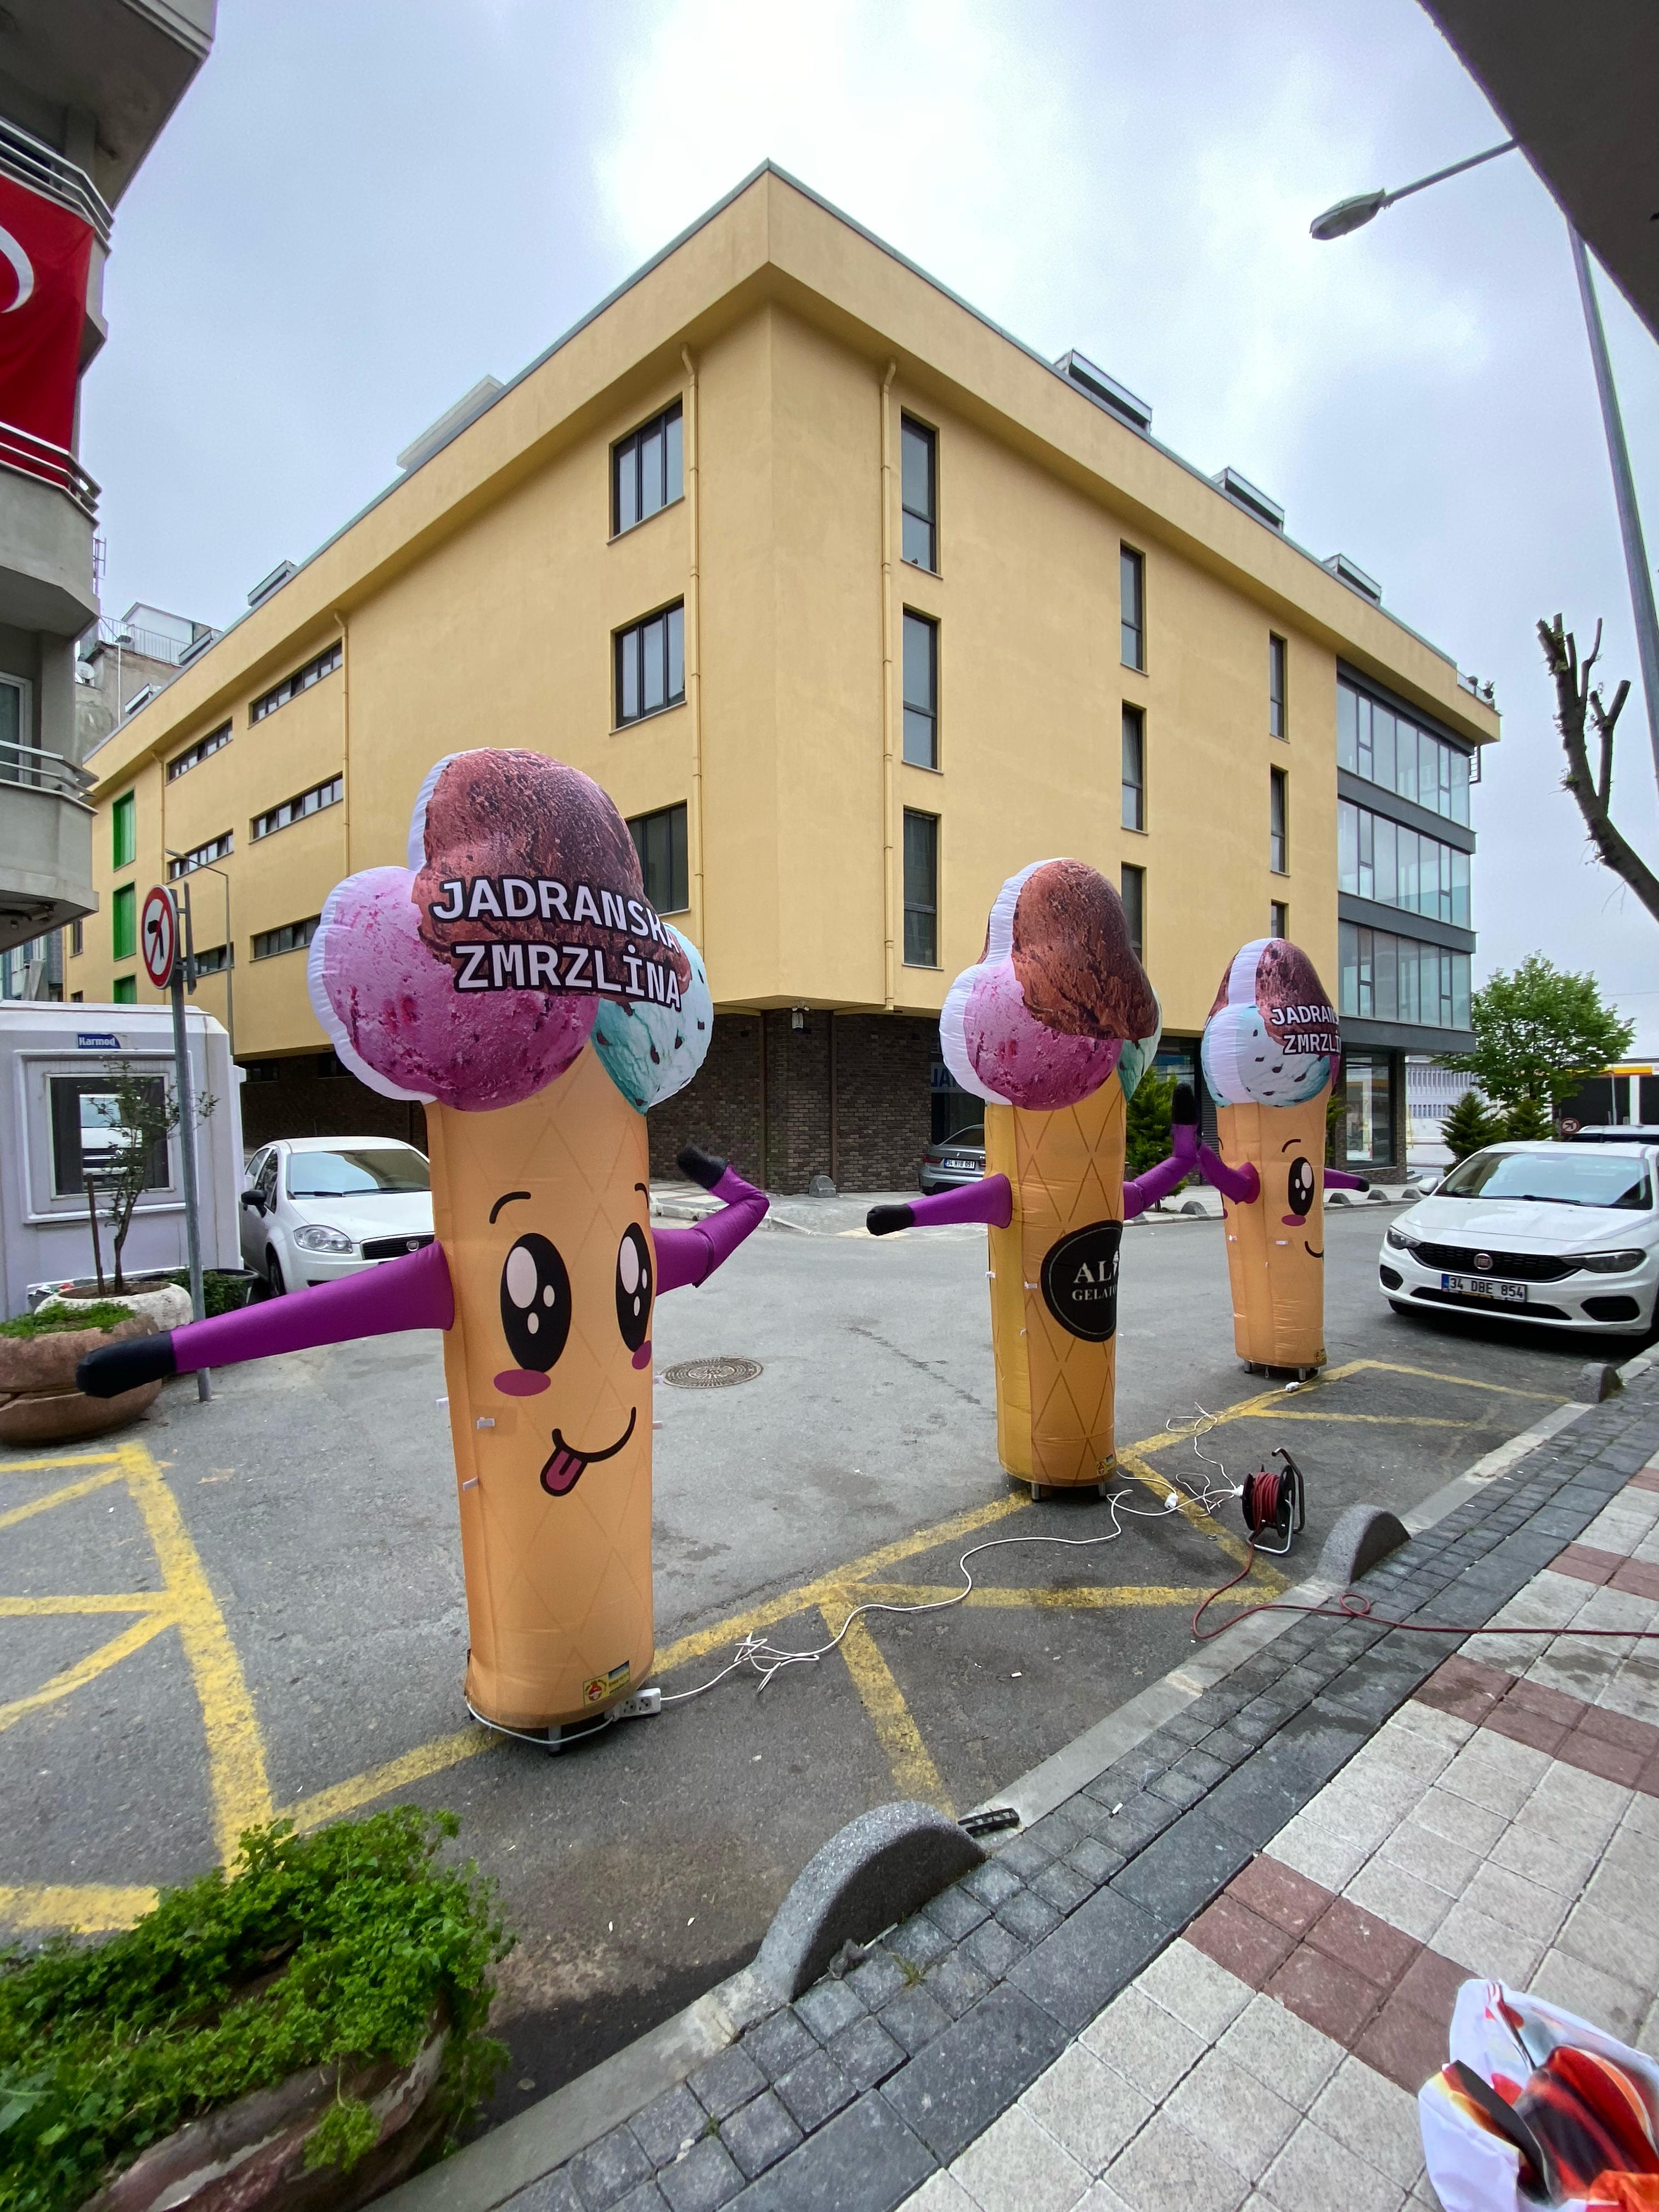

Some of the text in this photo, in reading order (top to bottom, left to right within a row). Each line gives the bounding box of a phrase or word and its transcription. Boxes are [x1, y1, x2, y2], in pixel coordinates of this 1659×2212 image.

[1450, 1278, 1463, 1289] 34
[1471, 1280, 1493, 1294] DBE
[1501, 1284, 1523, 1298] 854
